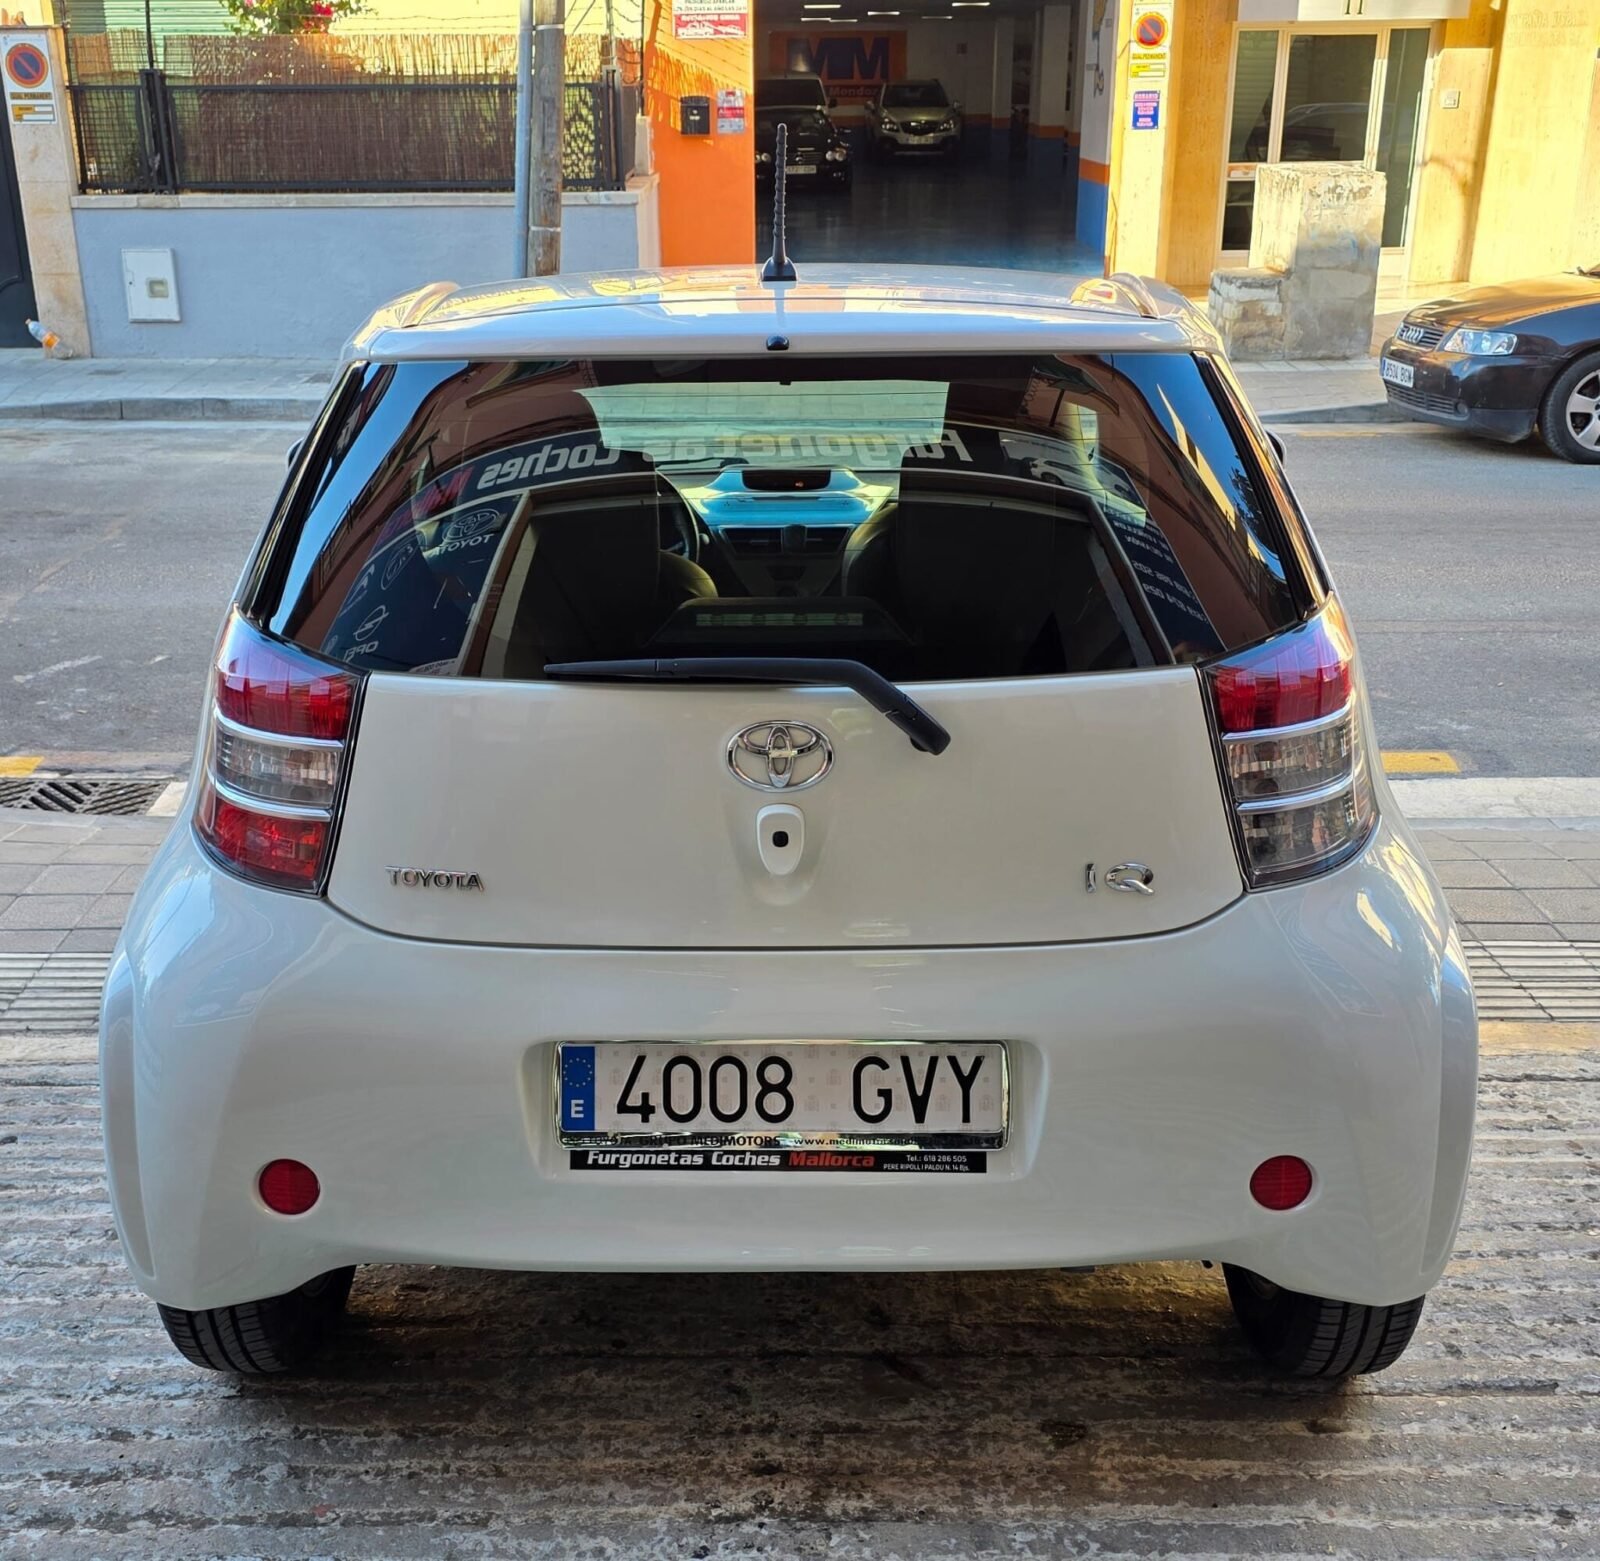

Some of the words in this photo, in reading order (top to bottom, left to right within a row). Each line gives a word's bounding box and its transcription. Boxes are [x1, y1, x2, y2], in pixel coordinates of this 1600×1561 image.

[384, 865, 484, 892] TOYOTA
[616, 1055, 795, 1124] 4008
[853, 1055, 985, 1124] GVY
[570, 1100, 585, 1118] E
[587, 1151, 704, 1168] Furgonetas
[711, 1151, 781, 1166] Coches
[789, 1152, 875, 1167] Mallorca
[952, 1155, 967, 1163] 505
